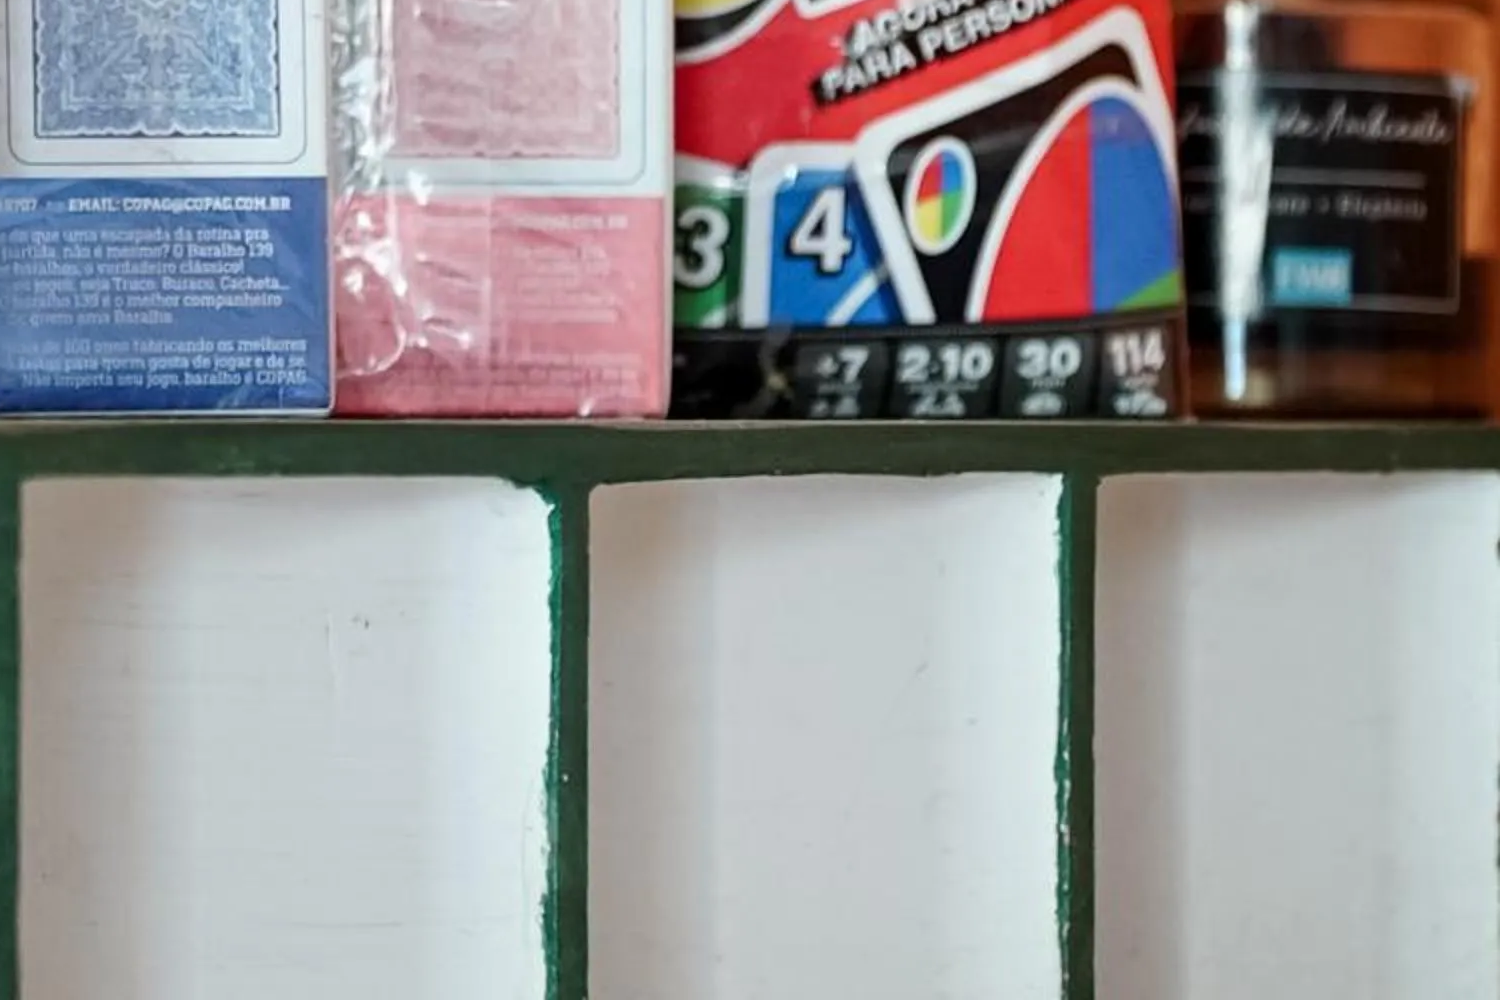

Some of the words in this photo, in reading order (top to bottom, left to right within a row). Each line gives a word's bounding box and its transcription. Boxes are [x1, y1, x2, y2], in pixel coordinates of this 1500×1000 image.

[819, 42, 917, 101] PARA
[68, 198, 120, 213] EMAIL:
[123, 197, 291, 214] COPAG@COPAG.COM.BR
[197, 227, 241, 242] rotina
[244, 229, 270, 246] pra
[790, 186, 853, 273] 4
[187, 243, 246, 258] Baralho
[249, 241, 274, 258] 139
[675, 206, 730, 288] 3
[126, 292, 180, 308] melhor
[183, 292, 283, 311] companheiro
[238, 336, 307, 353] melhores
[1018, 337, 1081, 379] 30
[1108, 328, 1166, 378] 114
